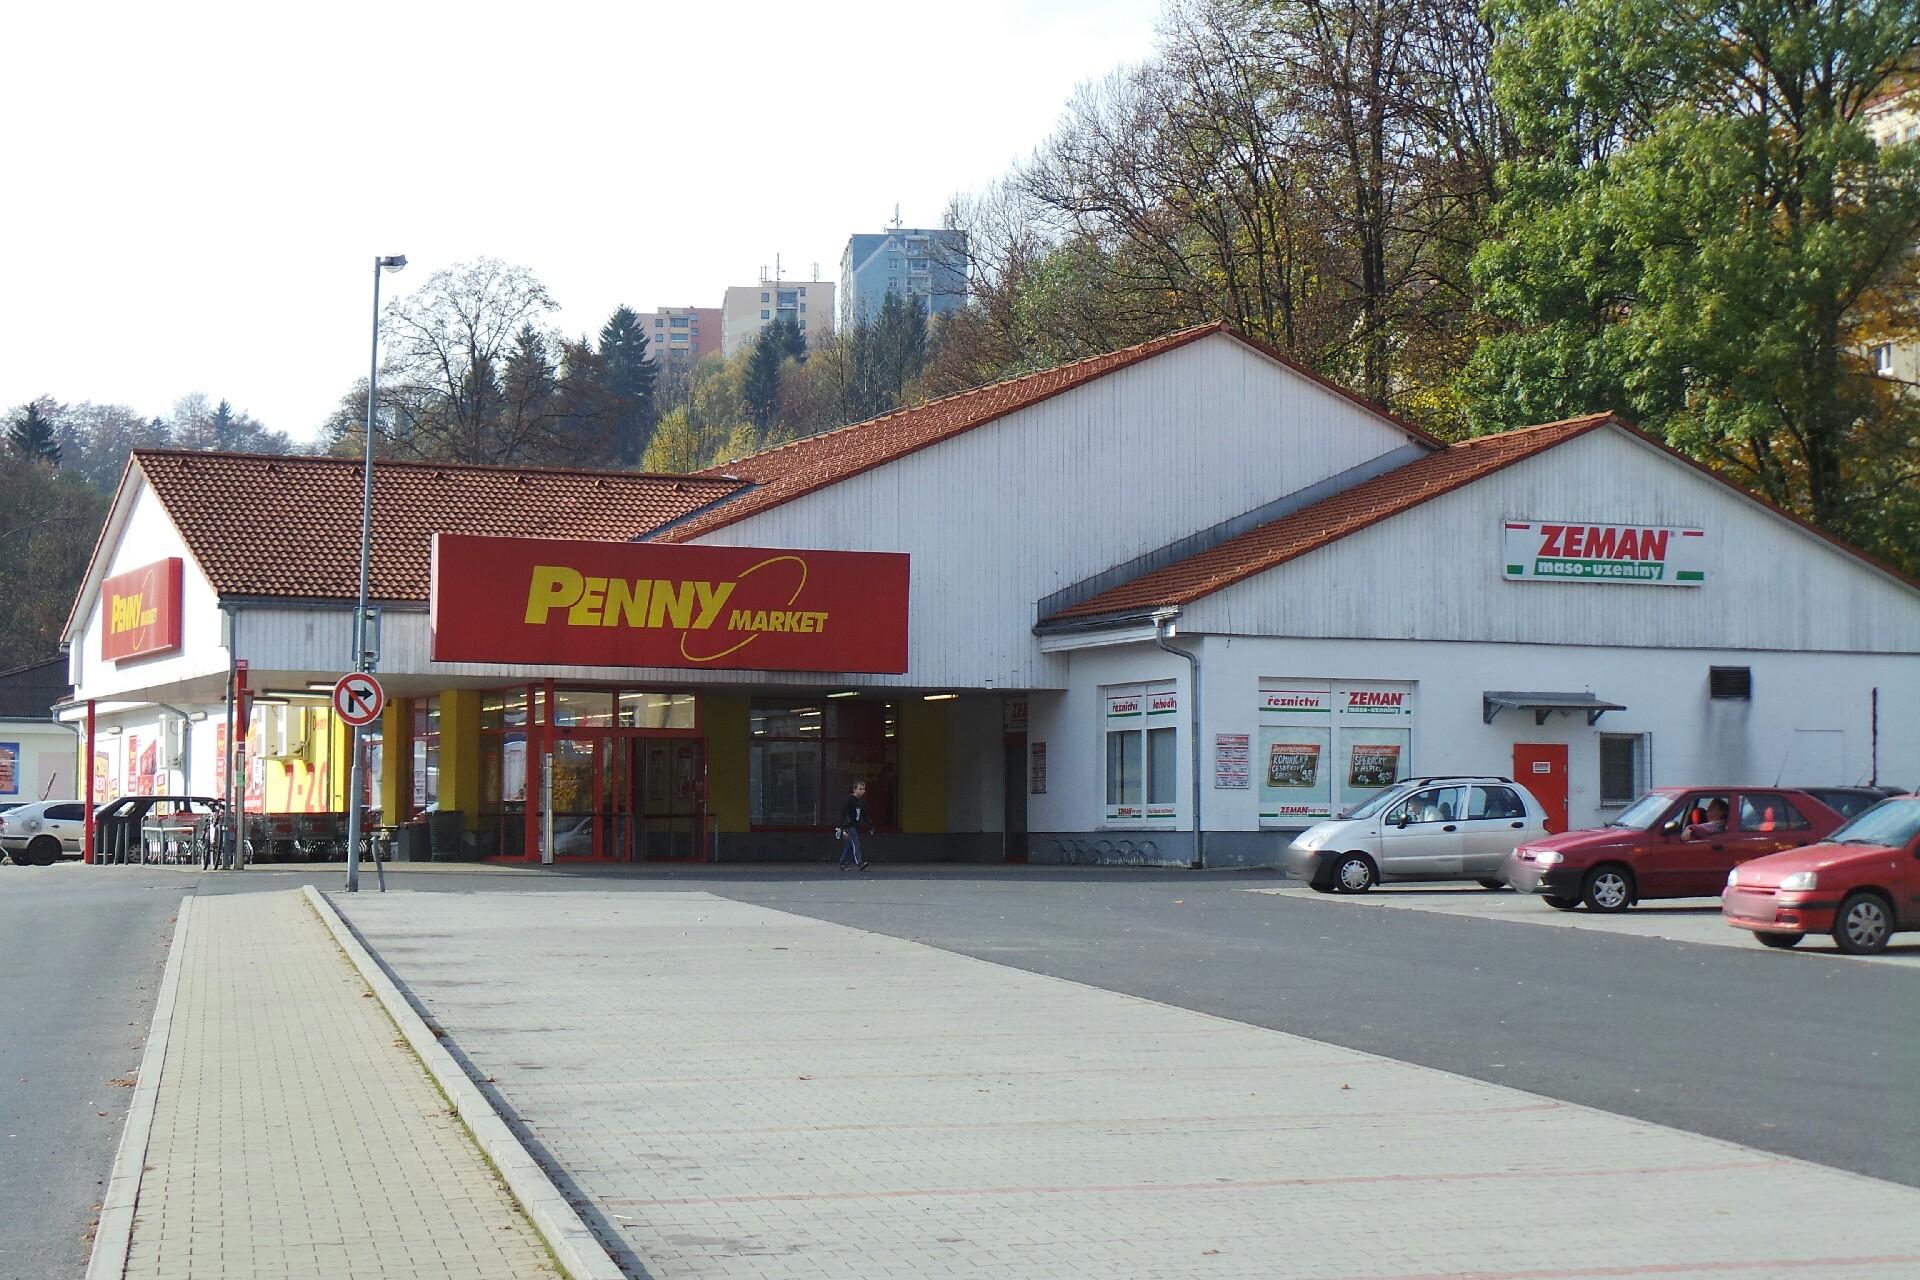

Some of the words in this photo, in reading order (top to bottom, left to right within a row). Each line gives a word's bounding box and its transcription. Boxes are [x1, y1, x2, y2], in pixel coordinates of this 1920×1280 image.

[1537, 525, 1669, 561] ZEMAN
[1537, 560, 1662, 580] maso-uzeniny
[524, 565, 737, 630] PENNY
[727, 609, 829, 633] MARKET
[111, 592, 143, 635] PENNY
[1267, 695, 1320, 707] řeznictví
[1348, 691, 1403, 706] ZEMAN
